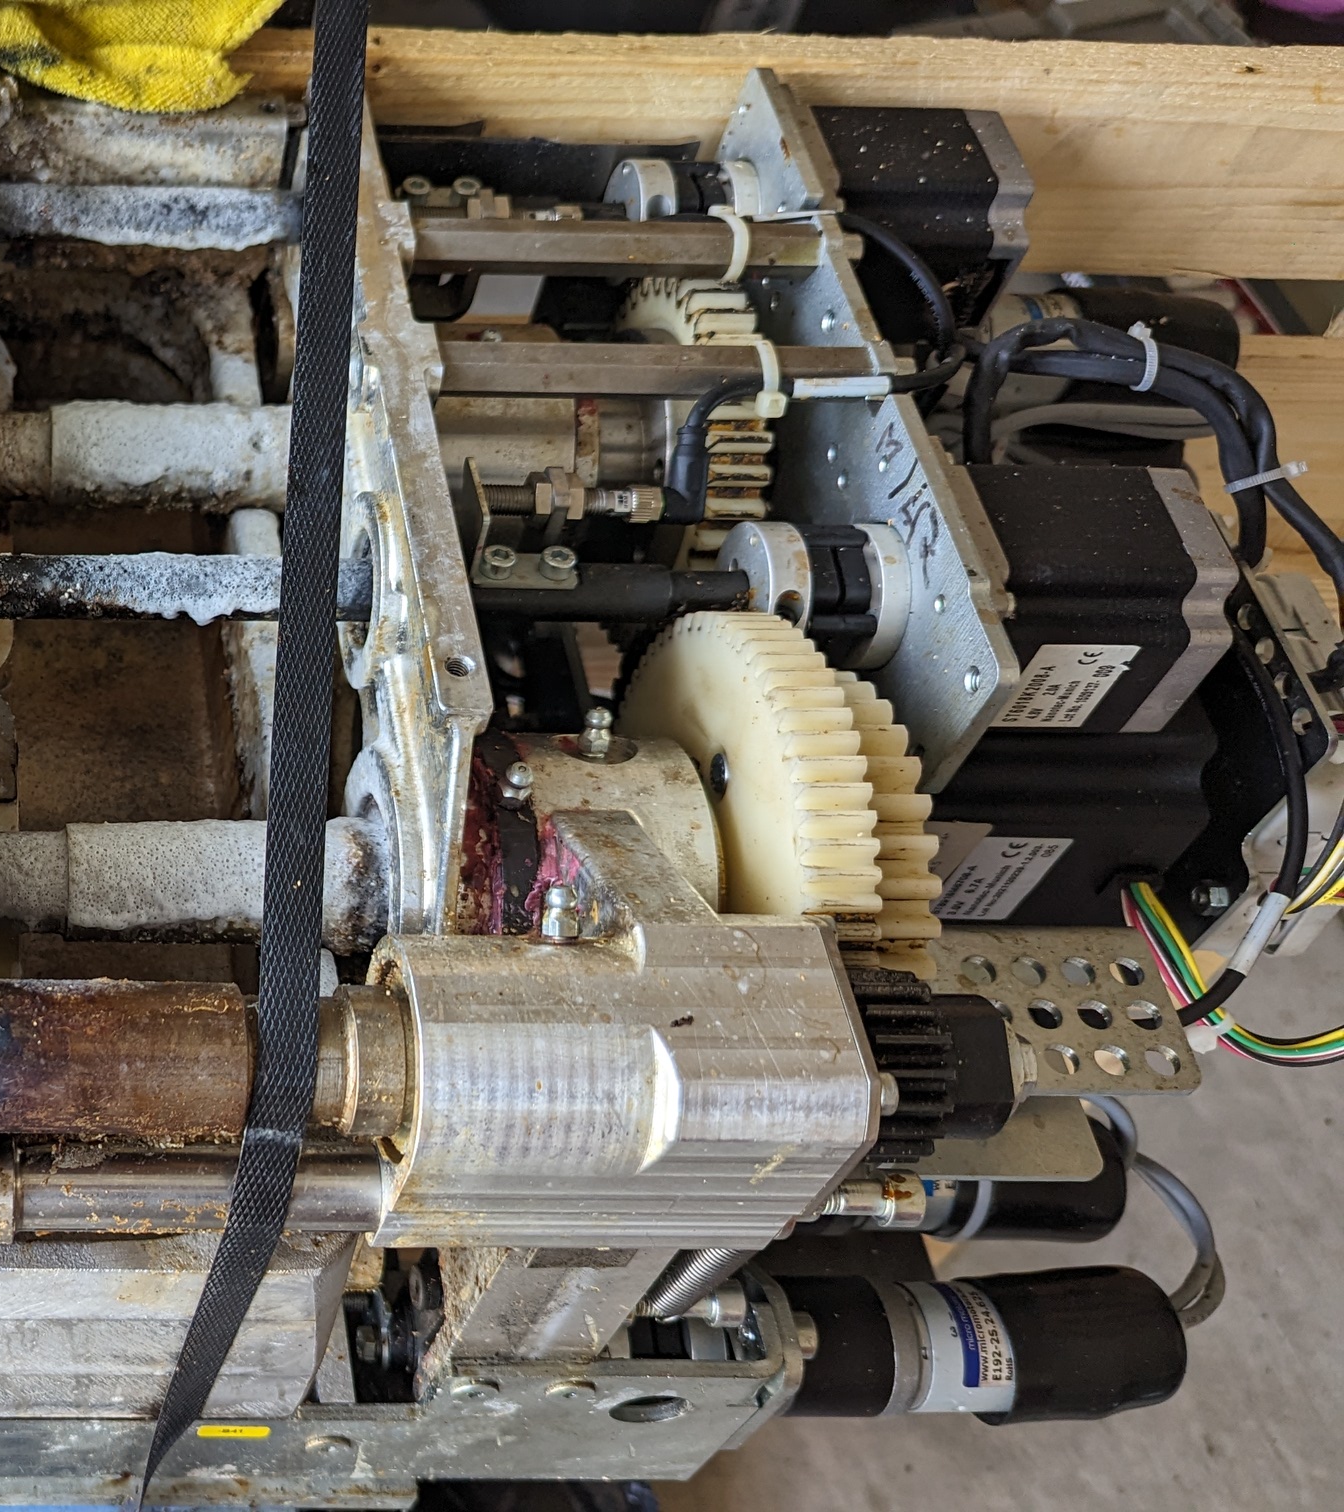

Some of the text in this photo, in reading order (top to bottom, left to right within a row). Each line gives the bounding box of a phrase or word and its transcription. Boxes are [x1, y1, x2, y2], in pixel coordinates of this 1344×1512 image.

[1040, 680, 1081, 722] Nanotec-Munich
[1042, 684, 1062, 695] 2.0A
[964, 1324, 975, 1351] micro
[1005, 1358, 1013, 1380] RoHS
